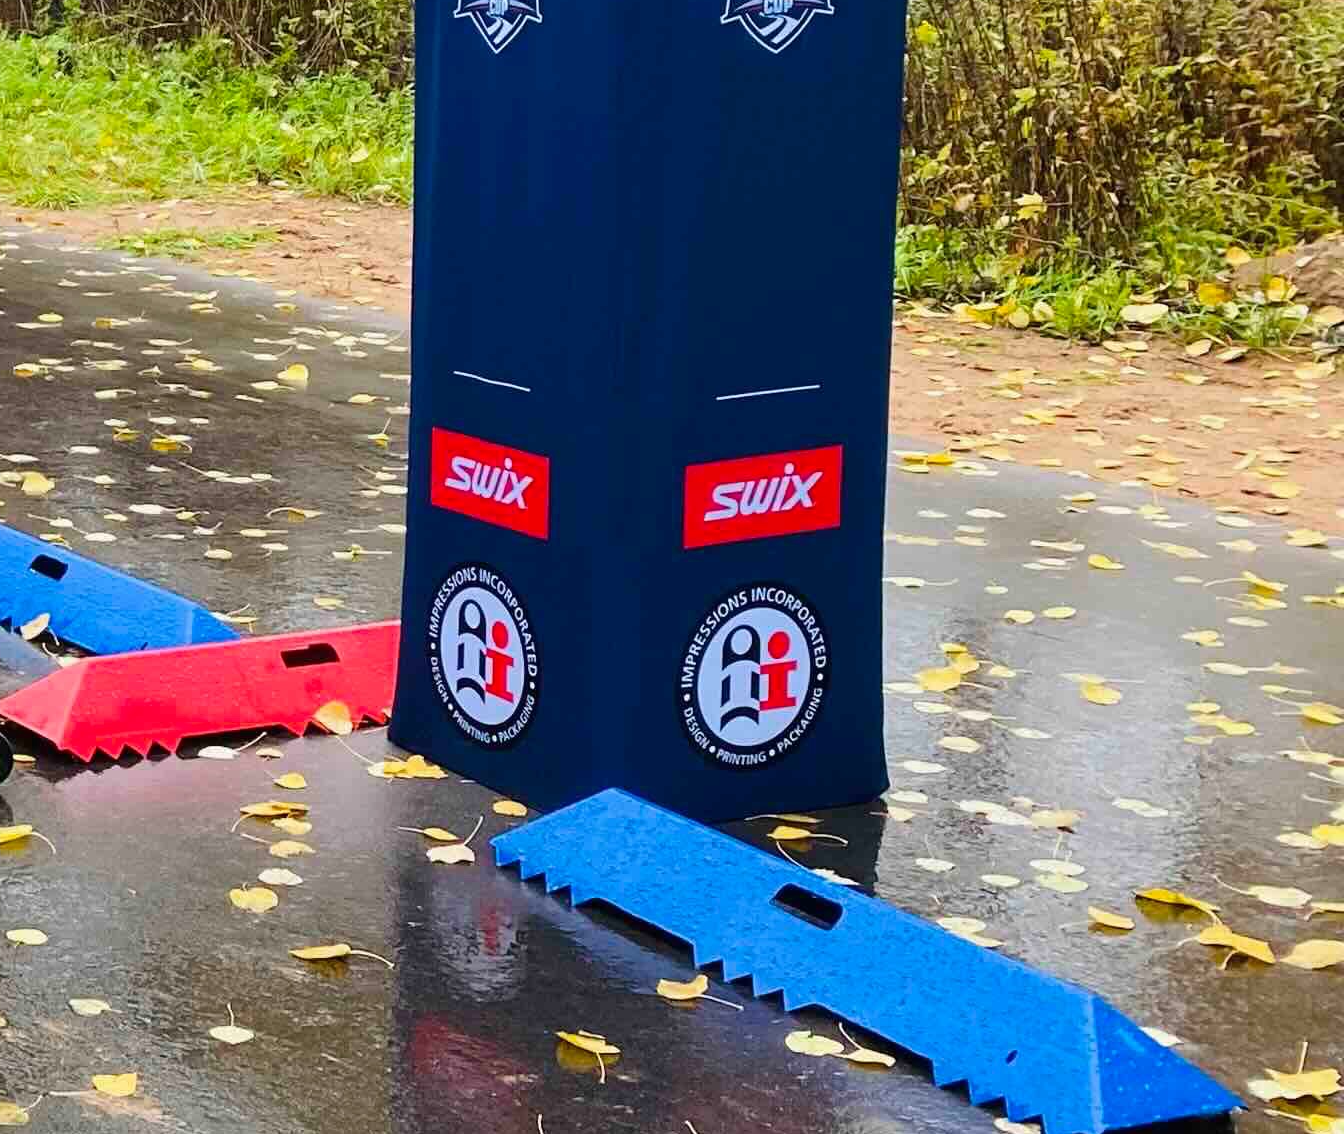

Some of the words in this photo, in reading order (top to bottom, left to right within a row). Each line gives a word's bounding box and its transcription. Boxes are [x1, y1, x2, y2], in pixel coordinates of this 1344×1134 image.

[429, 567, 477, 638] IMPRESSIONS
[479, 568, 538, 677] INCORPORATED
[681, 591, 748, 688] IMPRESSIONS
[751, 587, 827, 669] INCORPORATED
[430, 657, 449, 703] DESIGN
[452, 710, 491, 744] PRINTING
[497, 696, 535, 743] PACKAGING
[684, 707, 711, 749] DESIGN
[716, 748, 767, 765] PRINTING
[777, 687, 823, 753] PACKAGING
